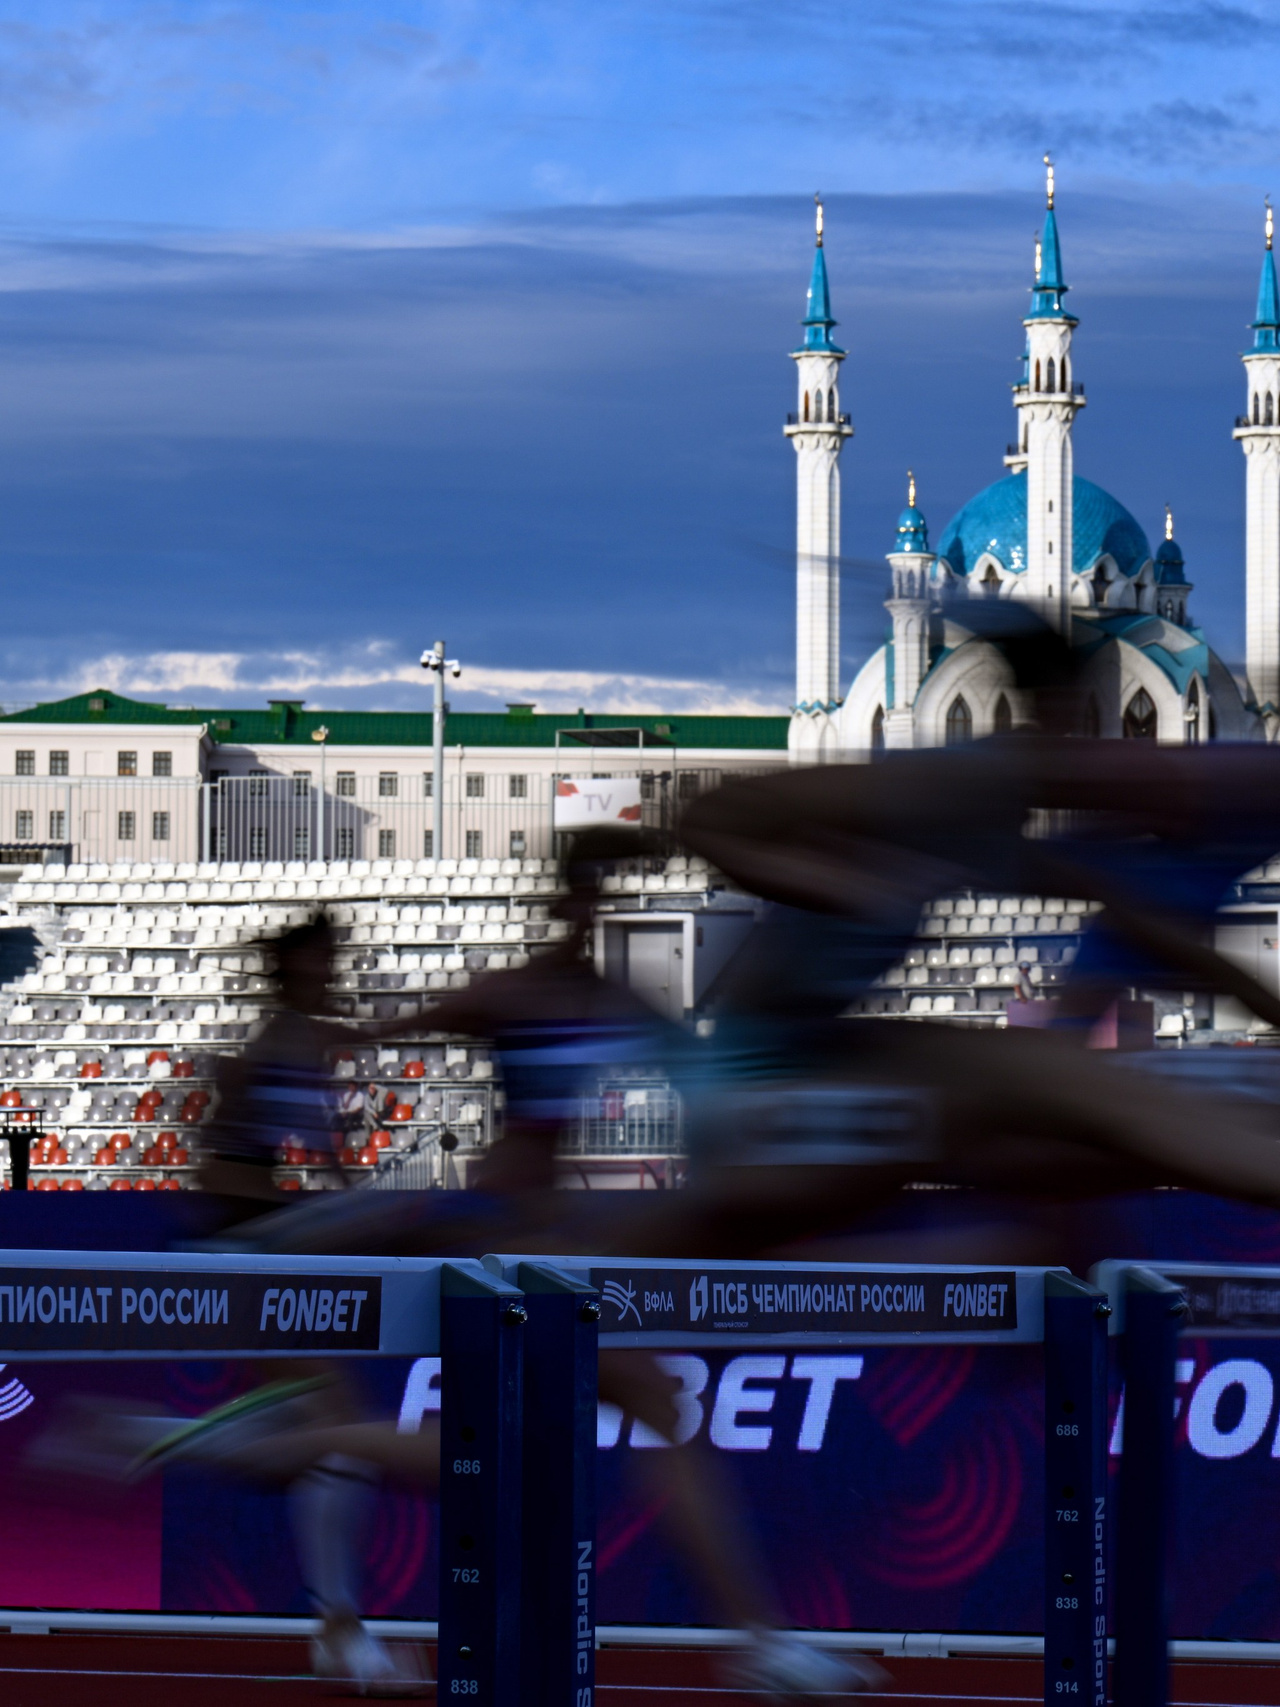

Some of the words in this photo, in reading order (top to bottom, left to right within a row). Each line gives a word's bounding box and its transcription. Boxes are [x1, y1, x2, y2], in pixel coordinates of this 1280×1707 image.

[584, 794, 612, 811] TV
[121, 1287, 229, 1325] РОССИИ
[645, 1291, 675, 1312] ВФЛА
[713, 1283, 748, 1314] ПСБ
[752, 1284, 856, 1313] ЧЕМПИОНАТ
[861, 1284, 925, 1313] РОССИИ
[943, 1283, 1008, 1317] FONBET
[259, 1288, 368, 1332] FONBET
[1055, 1424, 1079, 1436] 686
[453, 1459, 481, 1475] 686
[1055, 1510, 1079, 1522] 762
[1094, 1497, 1106, 1605] Nordic
[452, 1568, 480, 1583] 762
[576, 1540, 592, 1675] Nordic
[1055, 1597, 1079, 1609] 838
[1093, 1615, 1106, 1707] Sport
[450, 1679, 479, 1694] 838
[1055, 1681, 1079, 1693] 914
